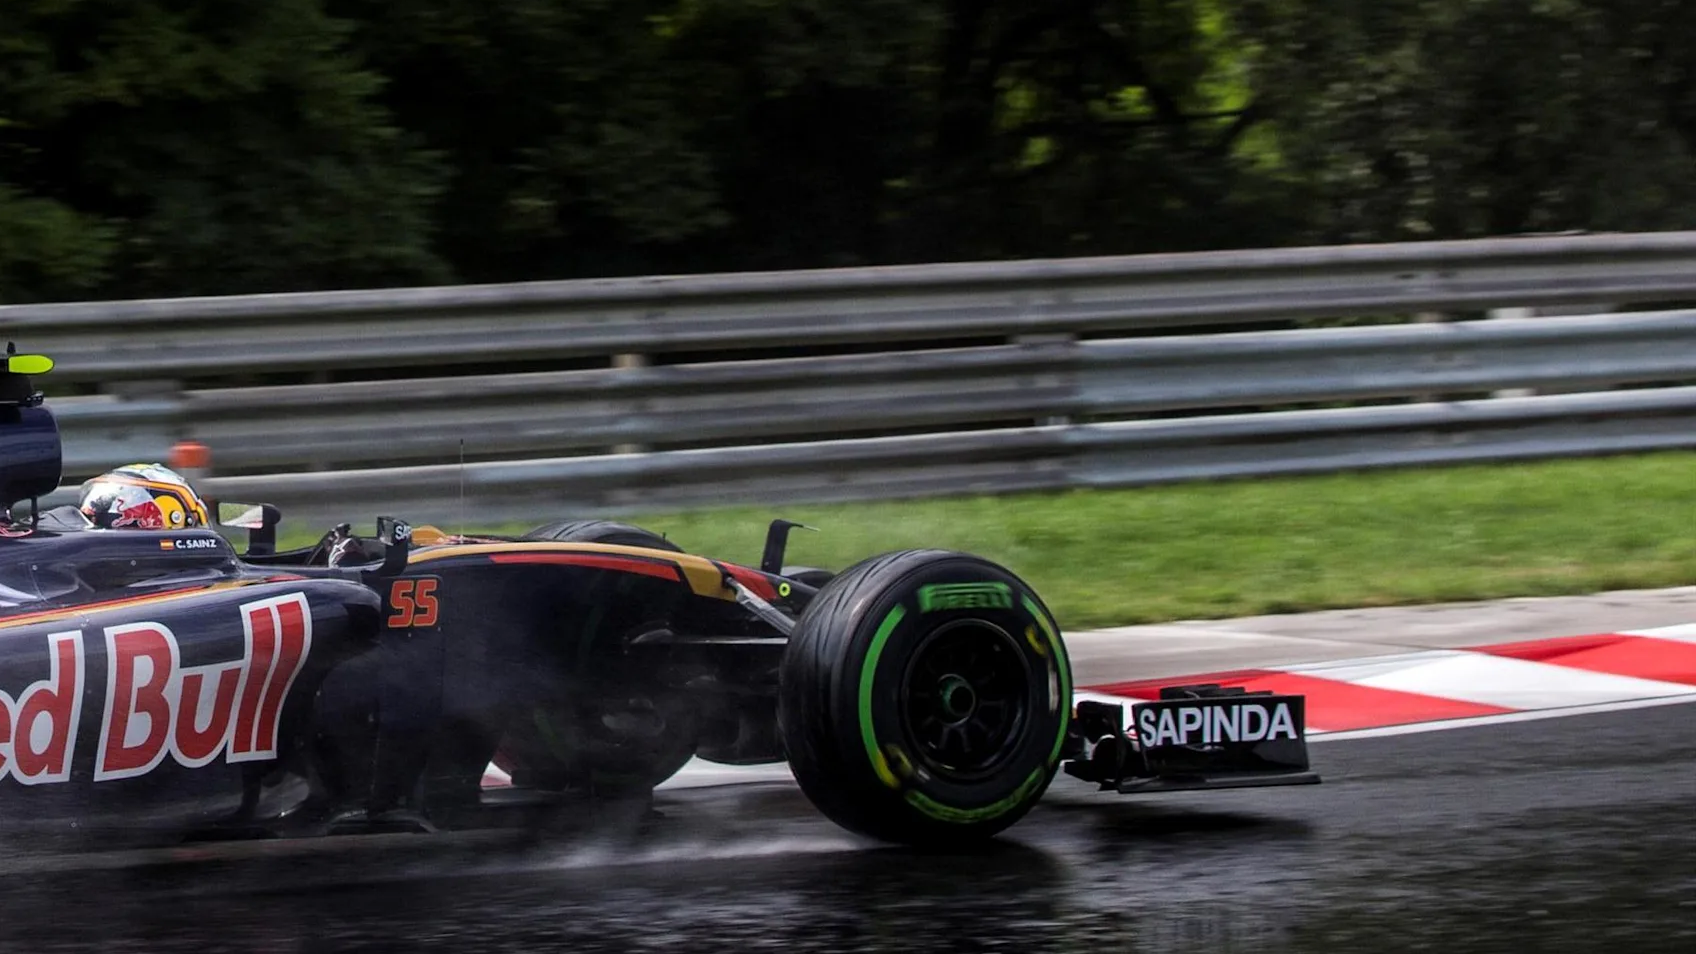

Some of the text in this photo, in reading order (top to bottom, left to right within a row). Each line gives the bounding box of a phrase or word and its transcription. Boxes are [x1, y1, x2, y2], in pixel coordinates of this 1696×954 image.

[186, 539, 217, 549] SAINZ
[388, 579, 439, 628] 55
[93, 592, 313, 783] Bull
[1140, 702, 1298, 747] SAPINDA
